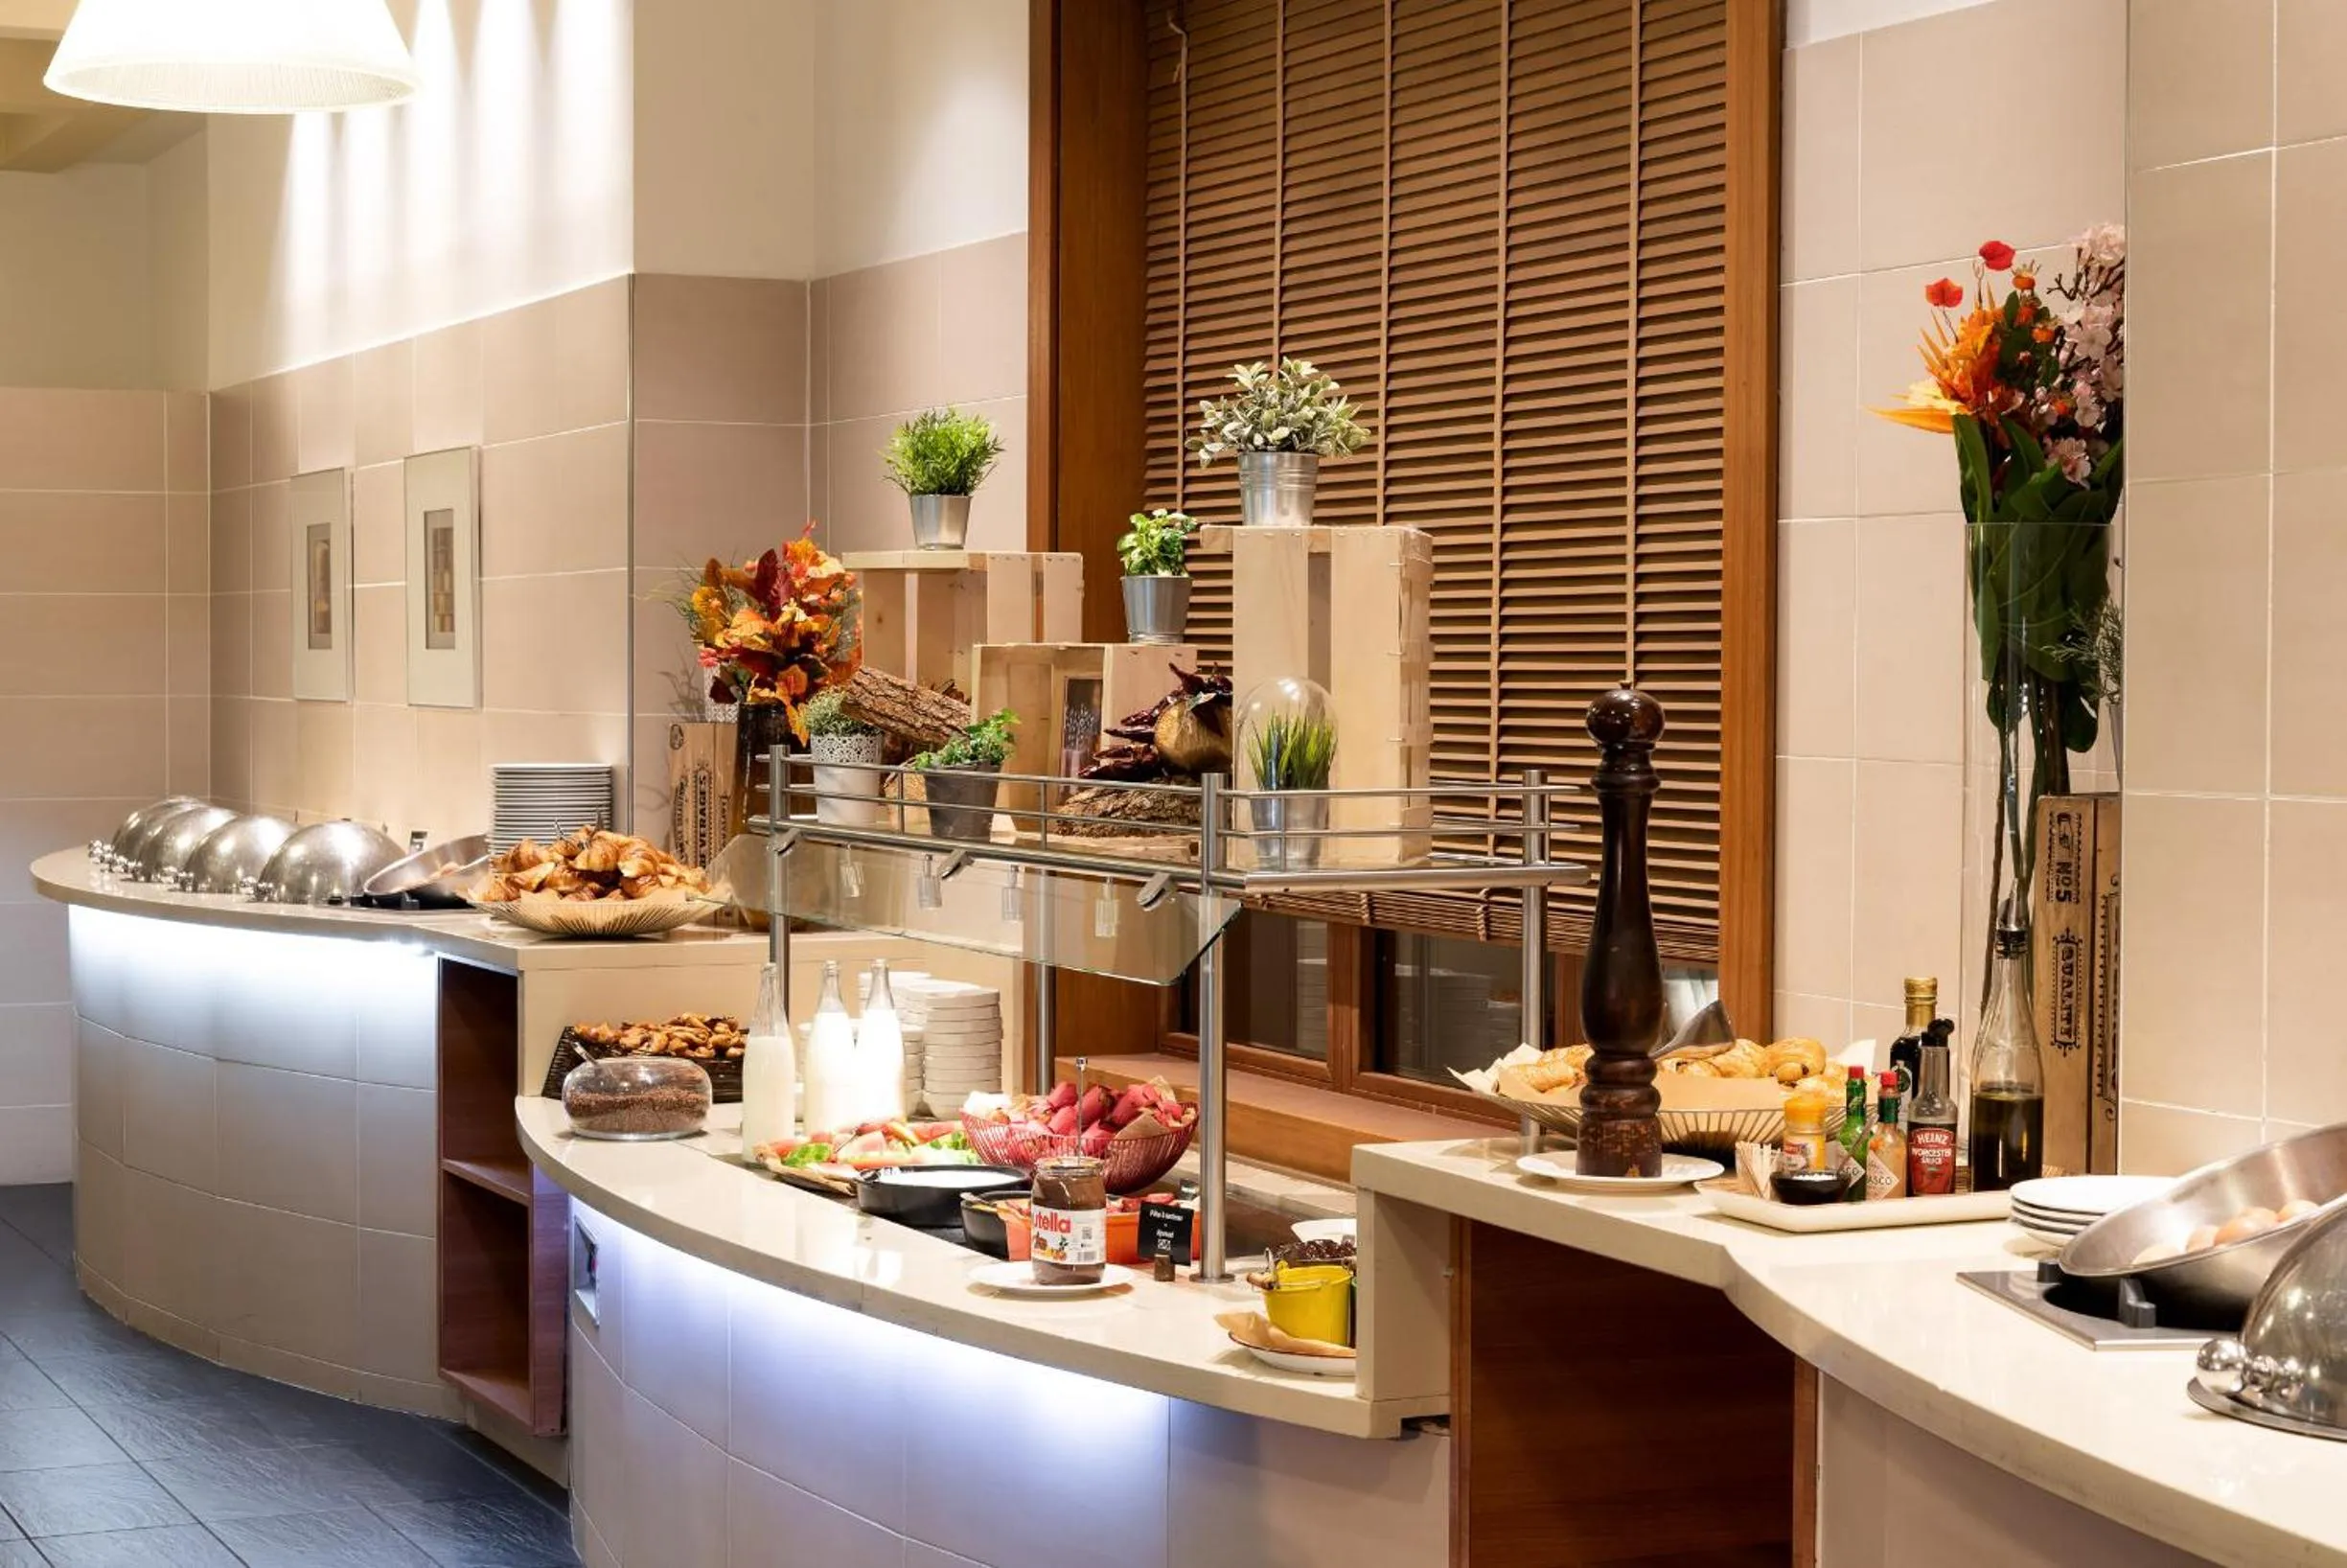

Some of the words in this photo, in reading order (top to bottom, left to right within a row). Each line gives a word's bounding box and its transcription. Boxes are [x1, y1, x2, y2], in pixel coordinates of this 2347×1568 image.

[2059, 946, 2074, 1039] QUALITY
[1917, 1132, 1948, 1145] HEINZ
[1921, 1157, 1943, 1165] SAUCE
[1867, 1176, 1892, 1186] ASCO
[1035, 1211, 1071, 1234] utella
